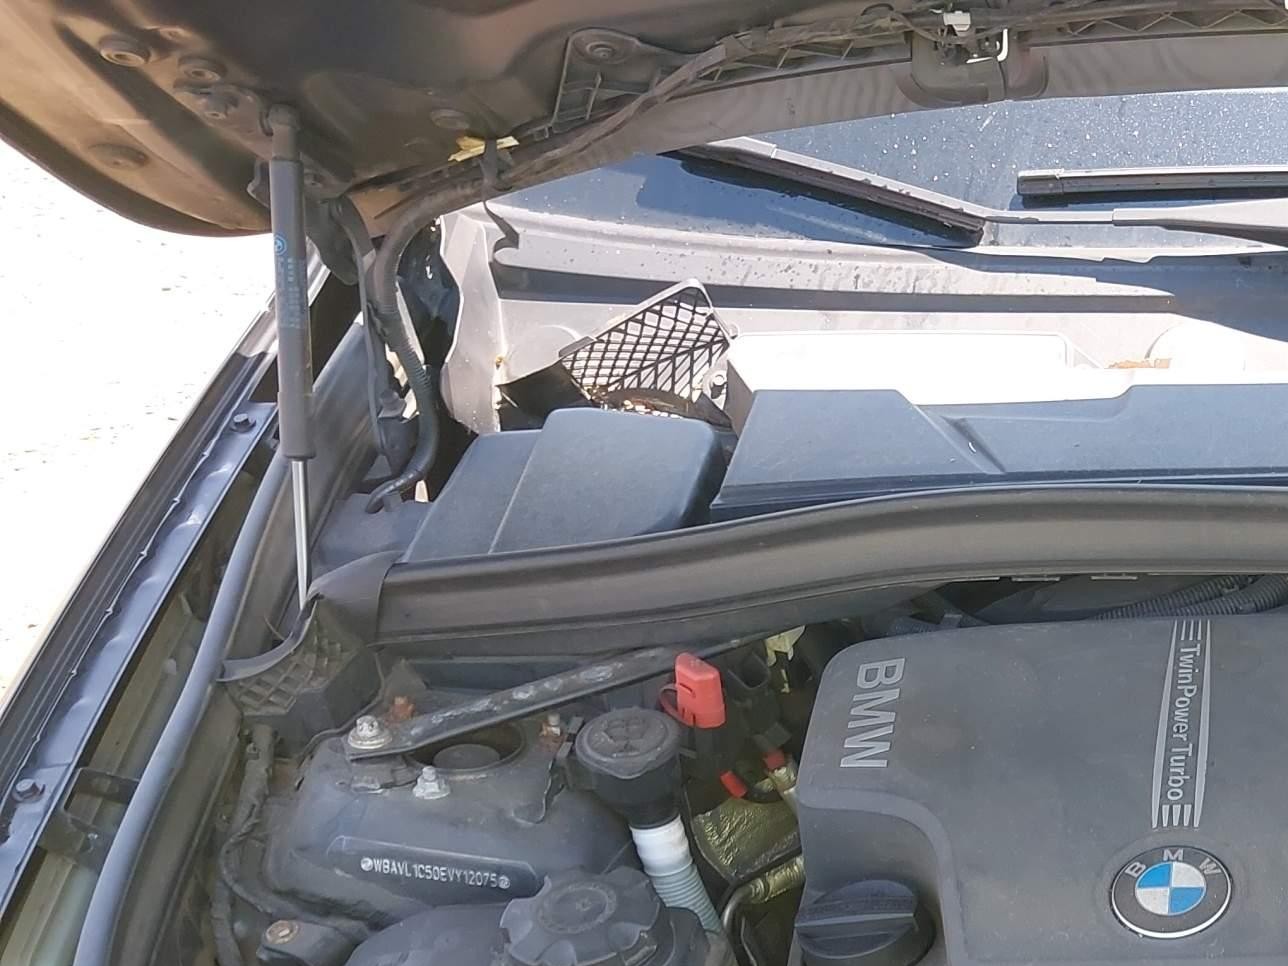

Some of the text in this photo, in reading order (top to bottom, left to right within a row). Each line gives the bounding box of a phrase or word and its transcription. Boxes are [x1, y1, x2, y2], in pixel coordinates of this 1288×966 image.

[840, 658, 905, 768] BMW
[1166, 643, 1200, 801] TwinPower Turbo
[1124, 847, 1222, 879] BMW
